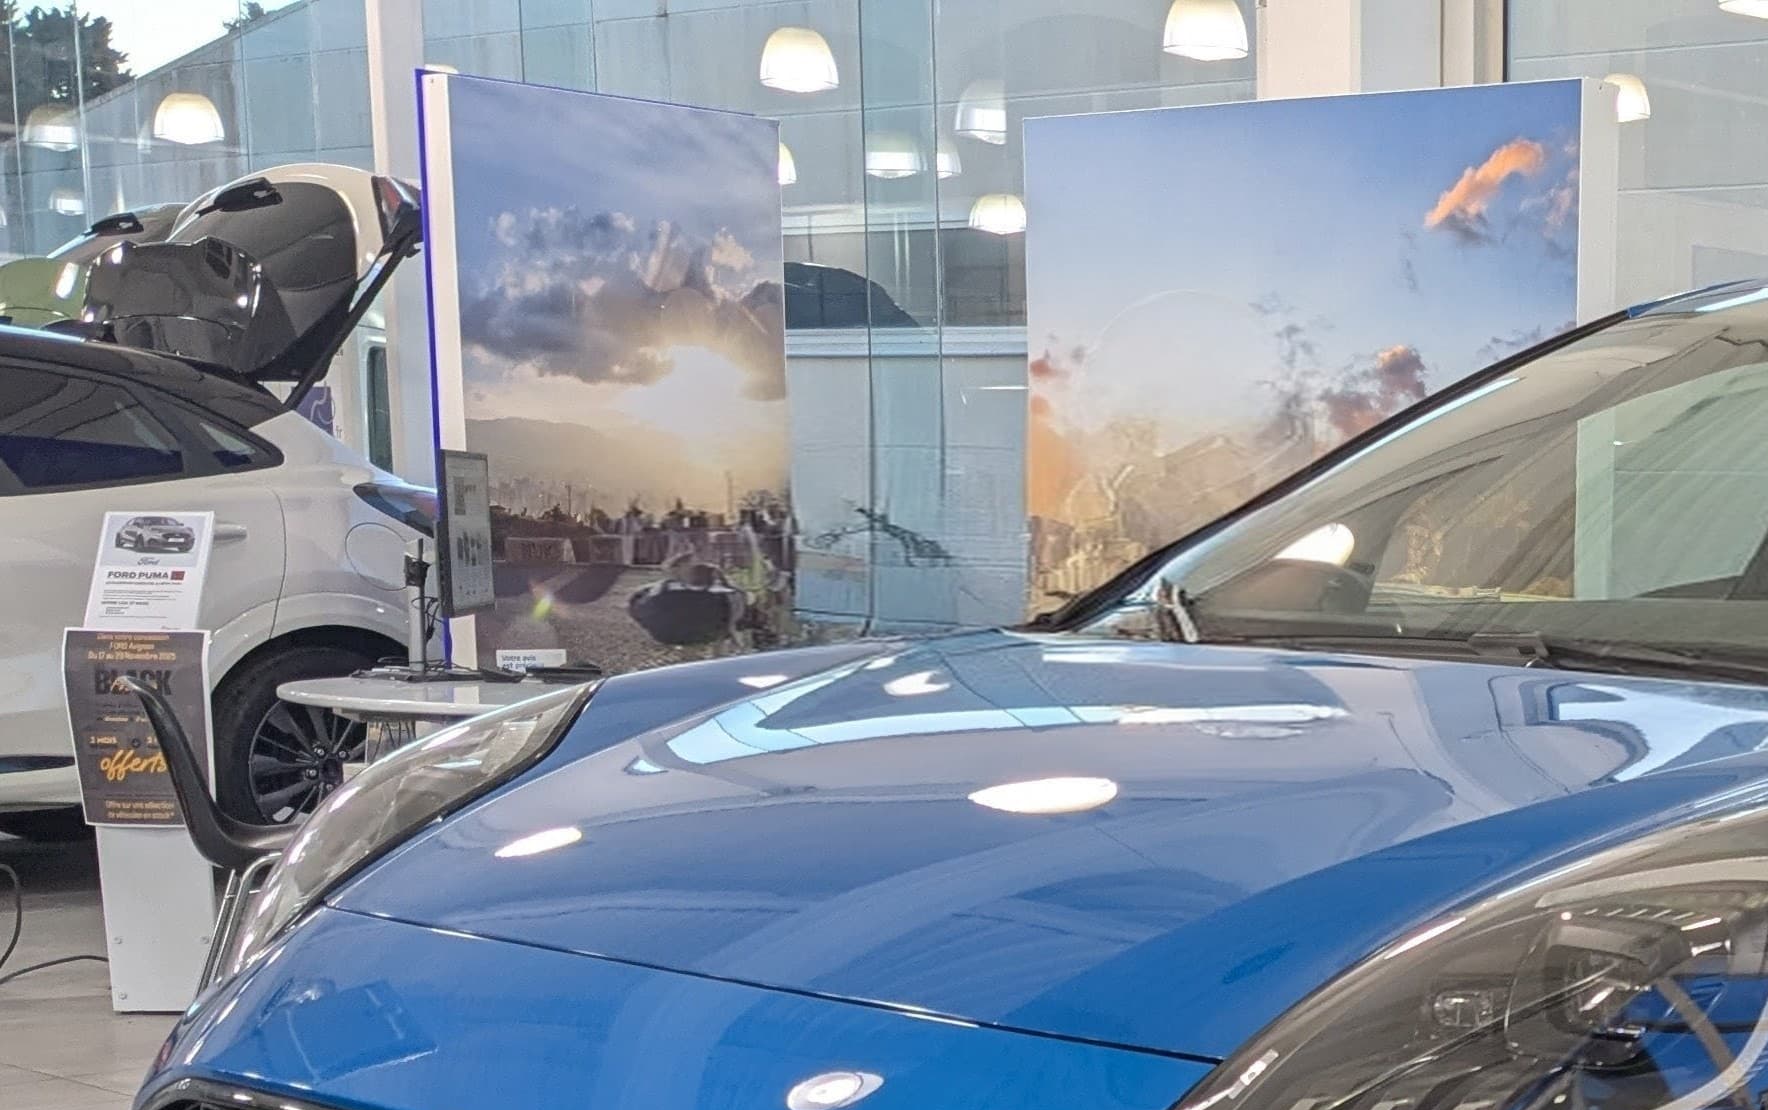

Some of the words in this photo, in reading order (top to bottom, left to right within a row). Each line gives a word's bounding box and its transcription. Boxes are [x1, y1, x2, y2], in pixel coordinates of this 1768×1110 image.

[107, 571, 137, 579] FORD
[138, 571, 169, 580] PUMA
[100, 749, 168, 781] offerts
